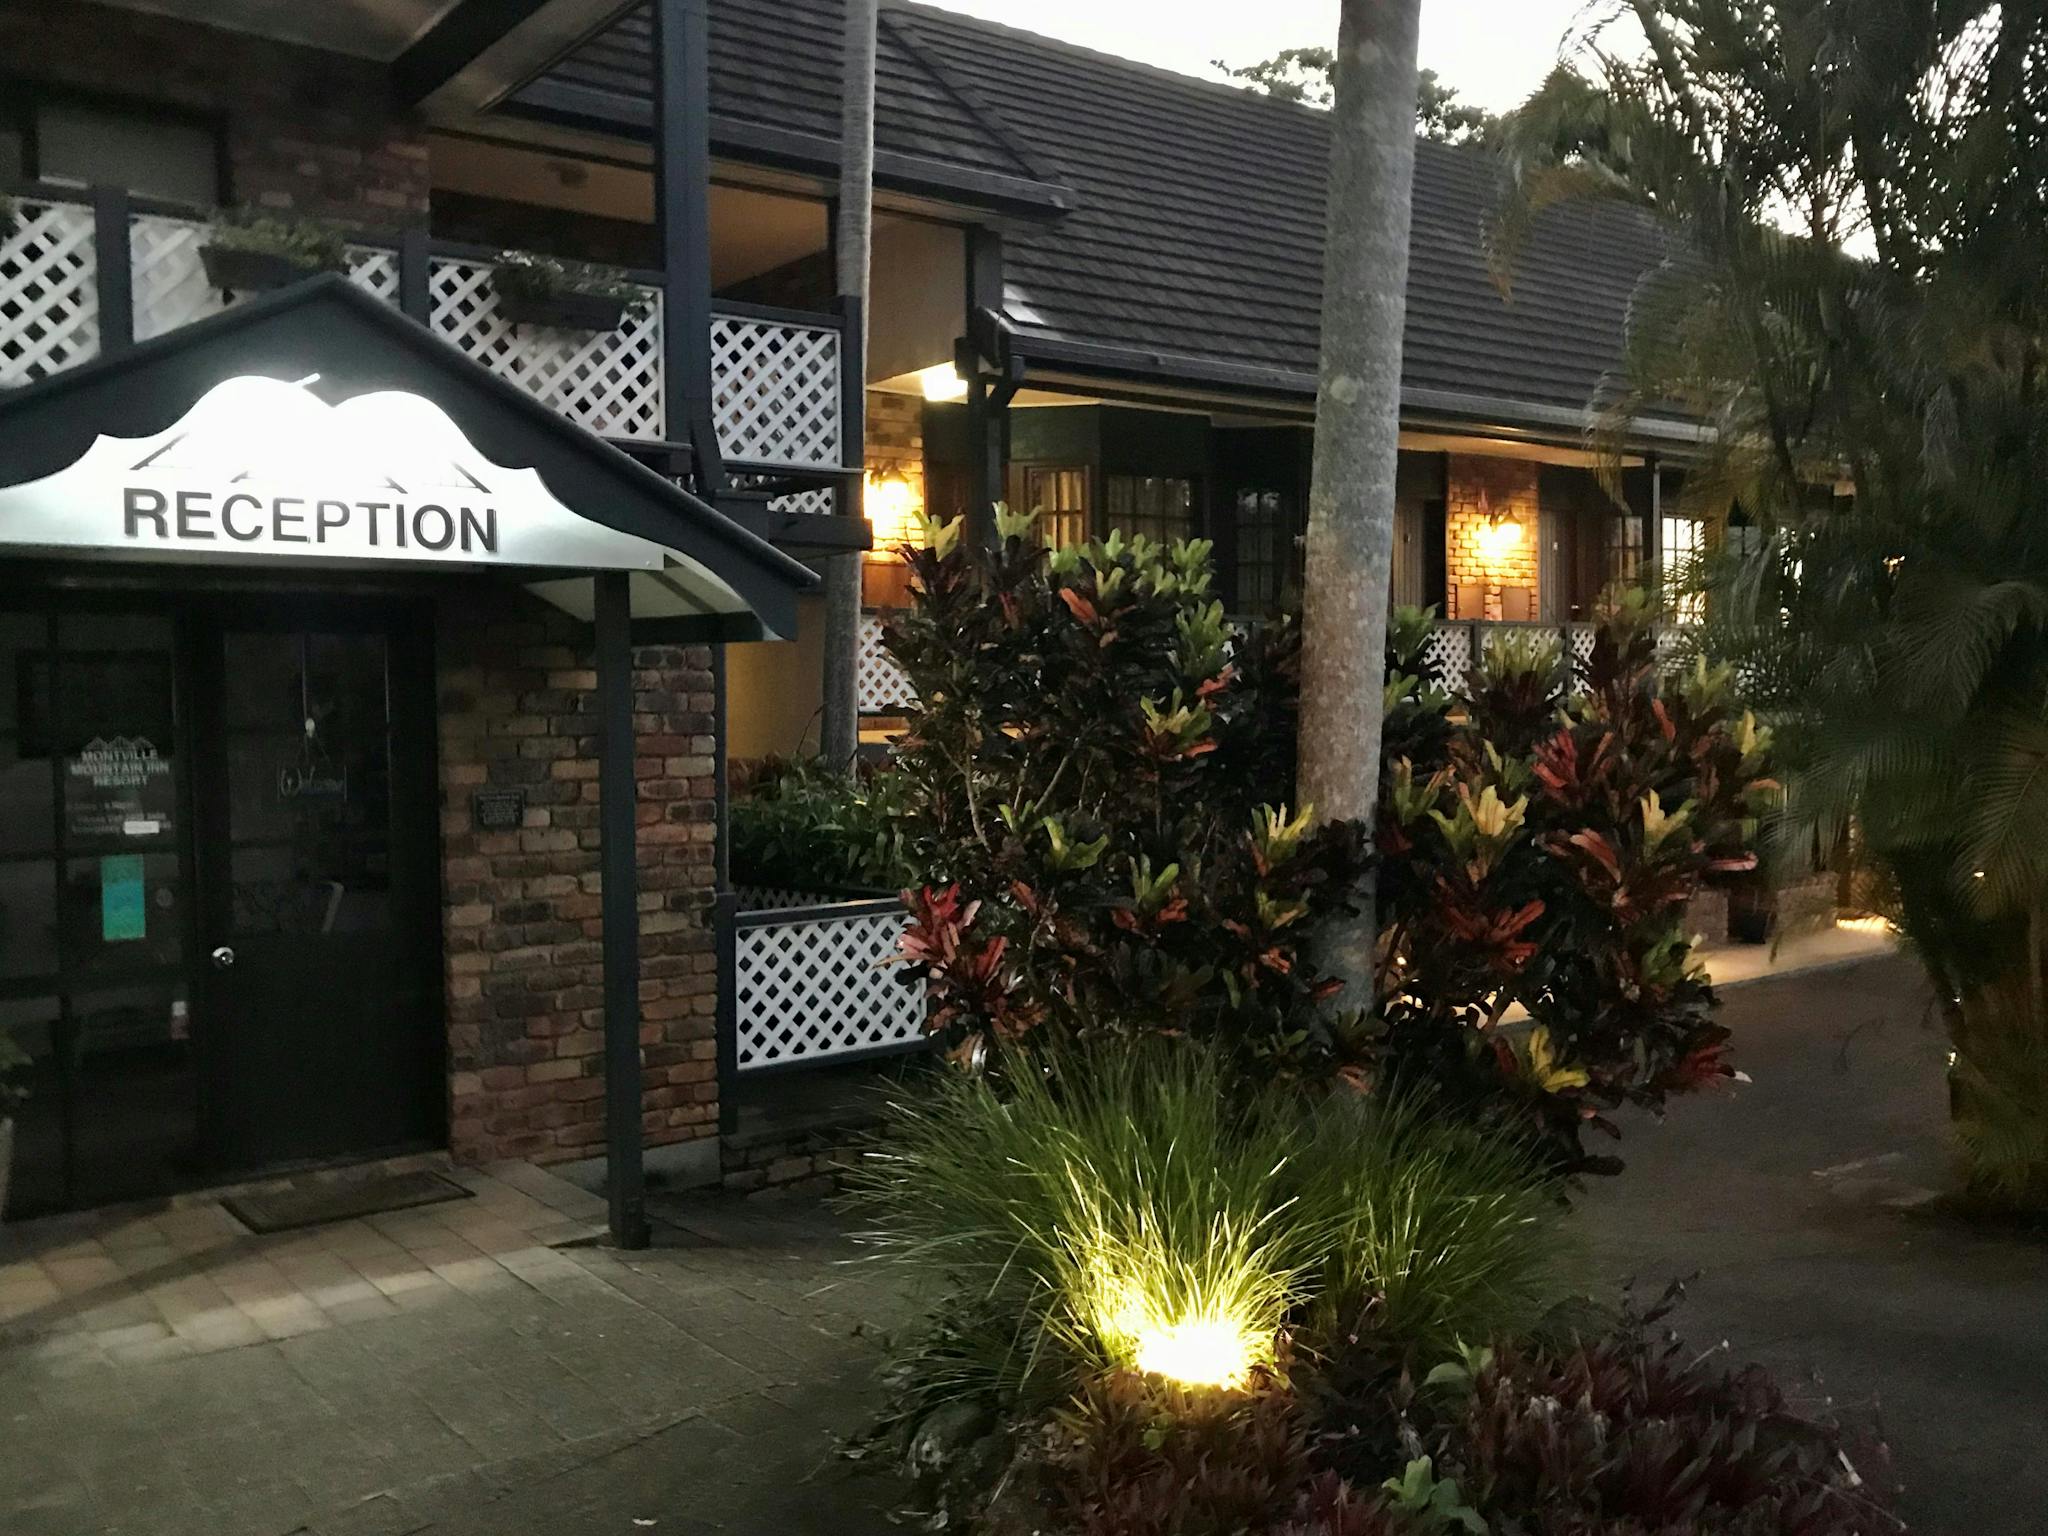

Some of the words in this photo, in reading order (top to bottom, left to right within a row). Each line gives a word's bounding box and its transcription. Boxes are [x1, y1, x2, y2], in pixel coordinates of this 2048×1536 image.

[123, 487, 499, 553] RECEPTION
[80, 748, 158, 762] MONTVILLE
[70, 761, 144, 775] MOUNTAIN
[93, 774, 148, 786] RESORT
